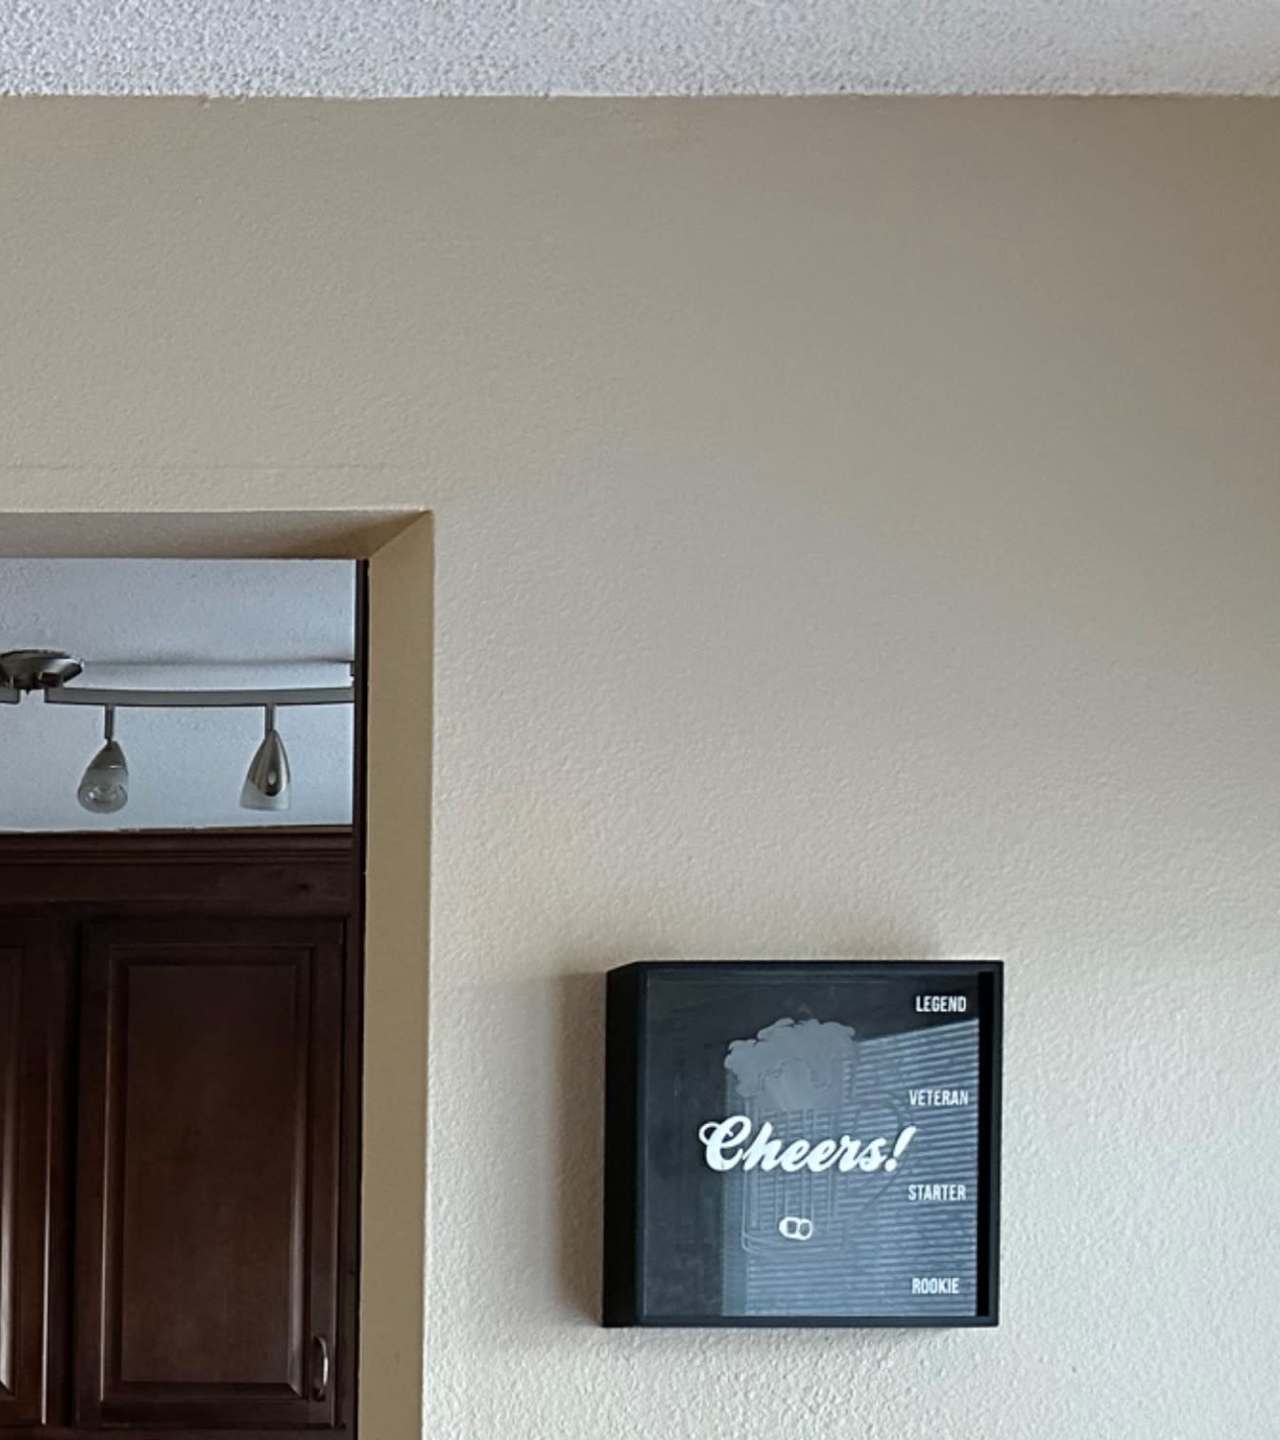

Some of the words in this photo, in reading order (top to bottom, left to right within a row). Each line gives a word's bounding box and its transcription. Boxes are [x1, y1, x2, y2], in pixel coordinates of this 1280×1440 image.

[916, 996, 967, 1013] LEGEND
[909, 1090, 968, 1106] VETERAN
[698, 1115, 917, 1172] Cheers!
[908, 1184, 966, 1200] STARTER
[912, 1278, 959, 1295] ROOKIE
